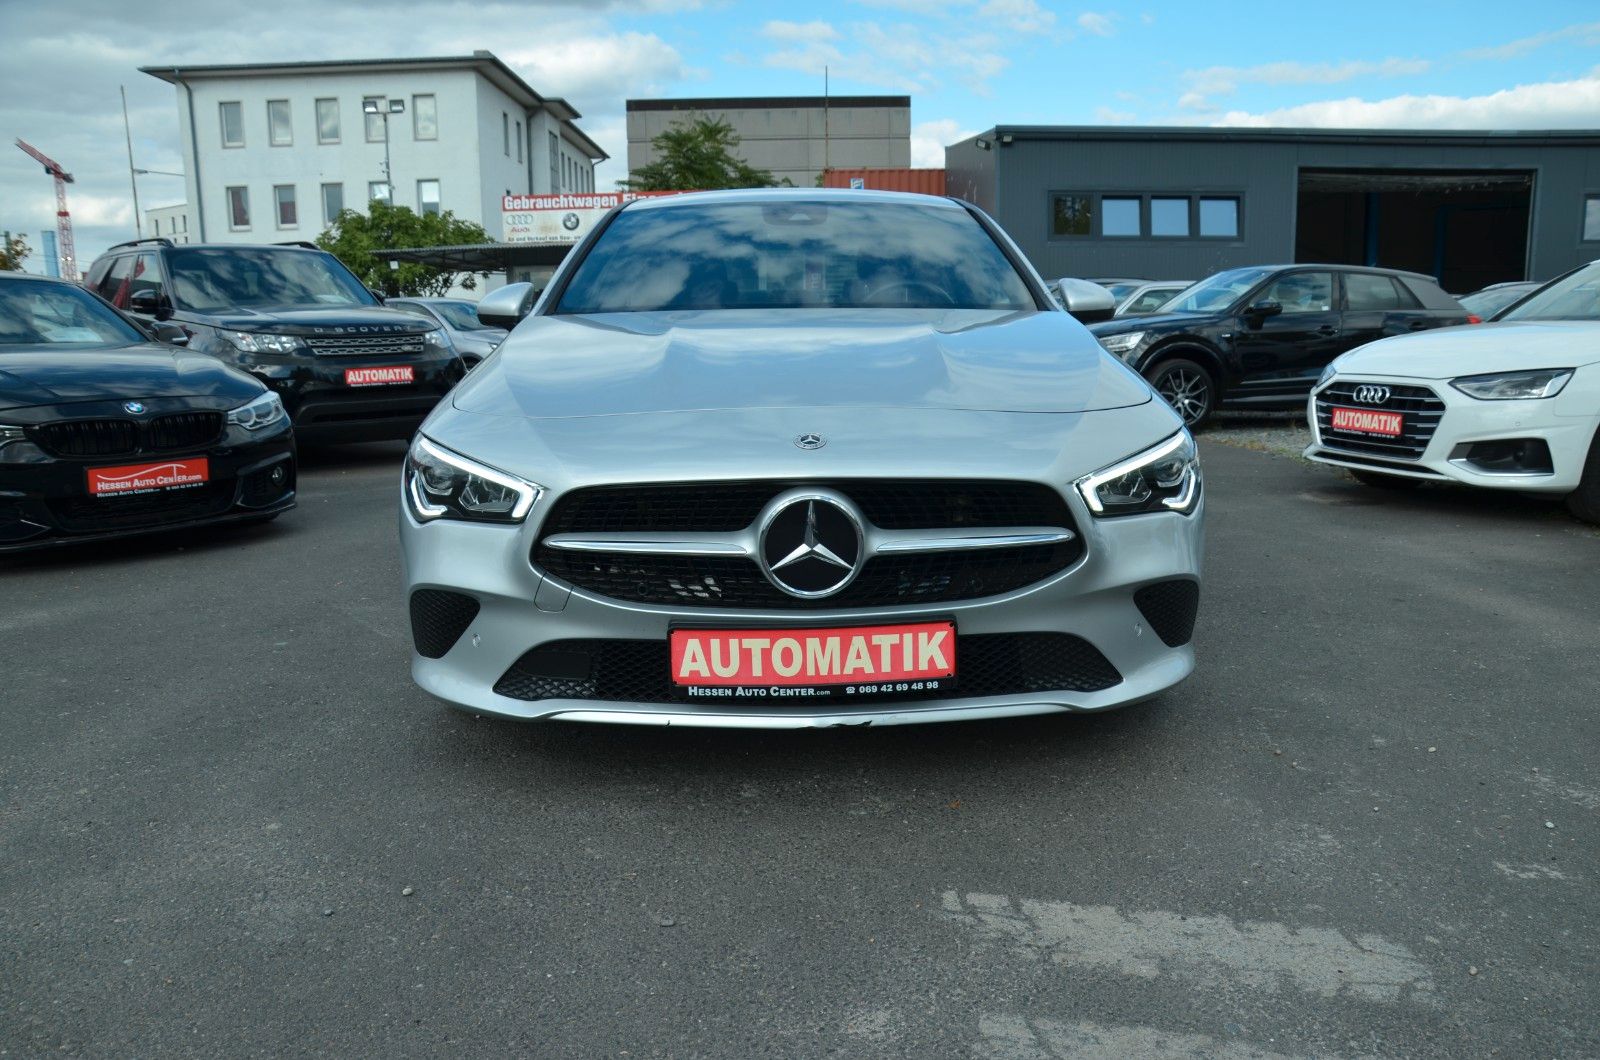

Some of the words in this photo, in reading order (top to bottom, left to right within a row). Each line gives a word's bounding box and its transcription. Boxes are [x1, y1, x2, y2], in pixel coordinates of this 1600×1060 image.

[504, 194, 618, 209] Gebrauchtwagen
[313, 325, 411, 333] DSCOVERY
[347, 367, 413, 383] AUTOMATIK
[1332, 410, 1401, 432] AUTOMATIK
[97, 481, 132, 491] HESSEN
[133, 478, 156, 488] AUTO
[679, 630, 949, 678] AUTOMATIK
[688, 686, 732, 697] HESSEN
[735, 686, 767, 697] AUTO
[770, 686, 831, 696] CENTER.com
[858, 685, 878, 694] 069
[880, 684, 893, 693] 42
[896, 683, 909, 691] 69
[911, 682, 924, 691] 48
[926, 681, 939, 690] 98
